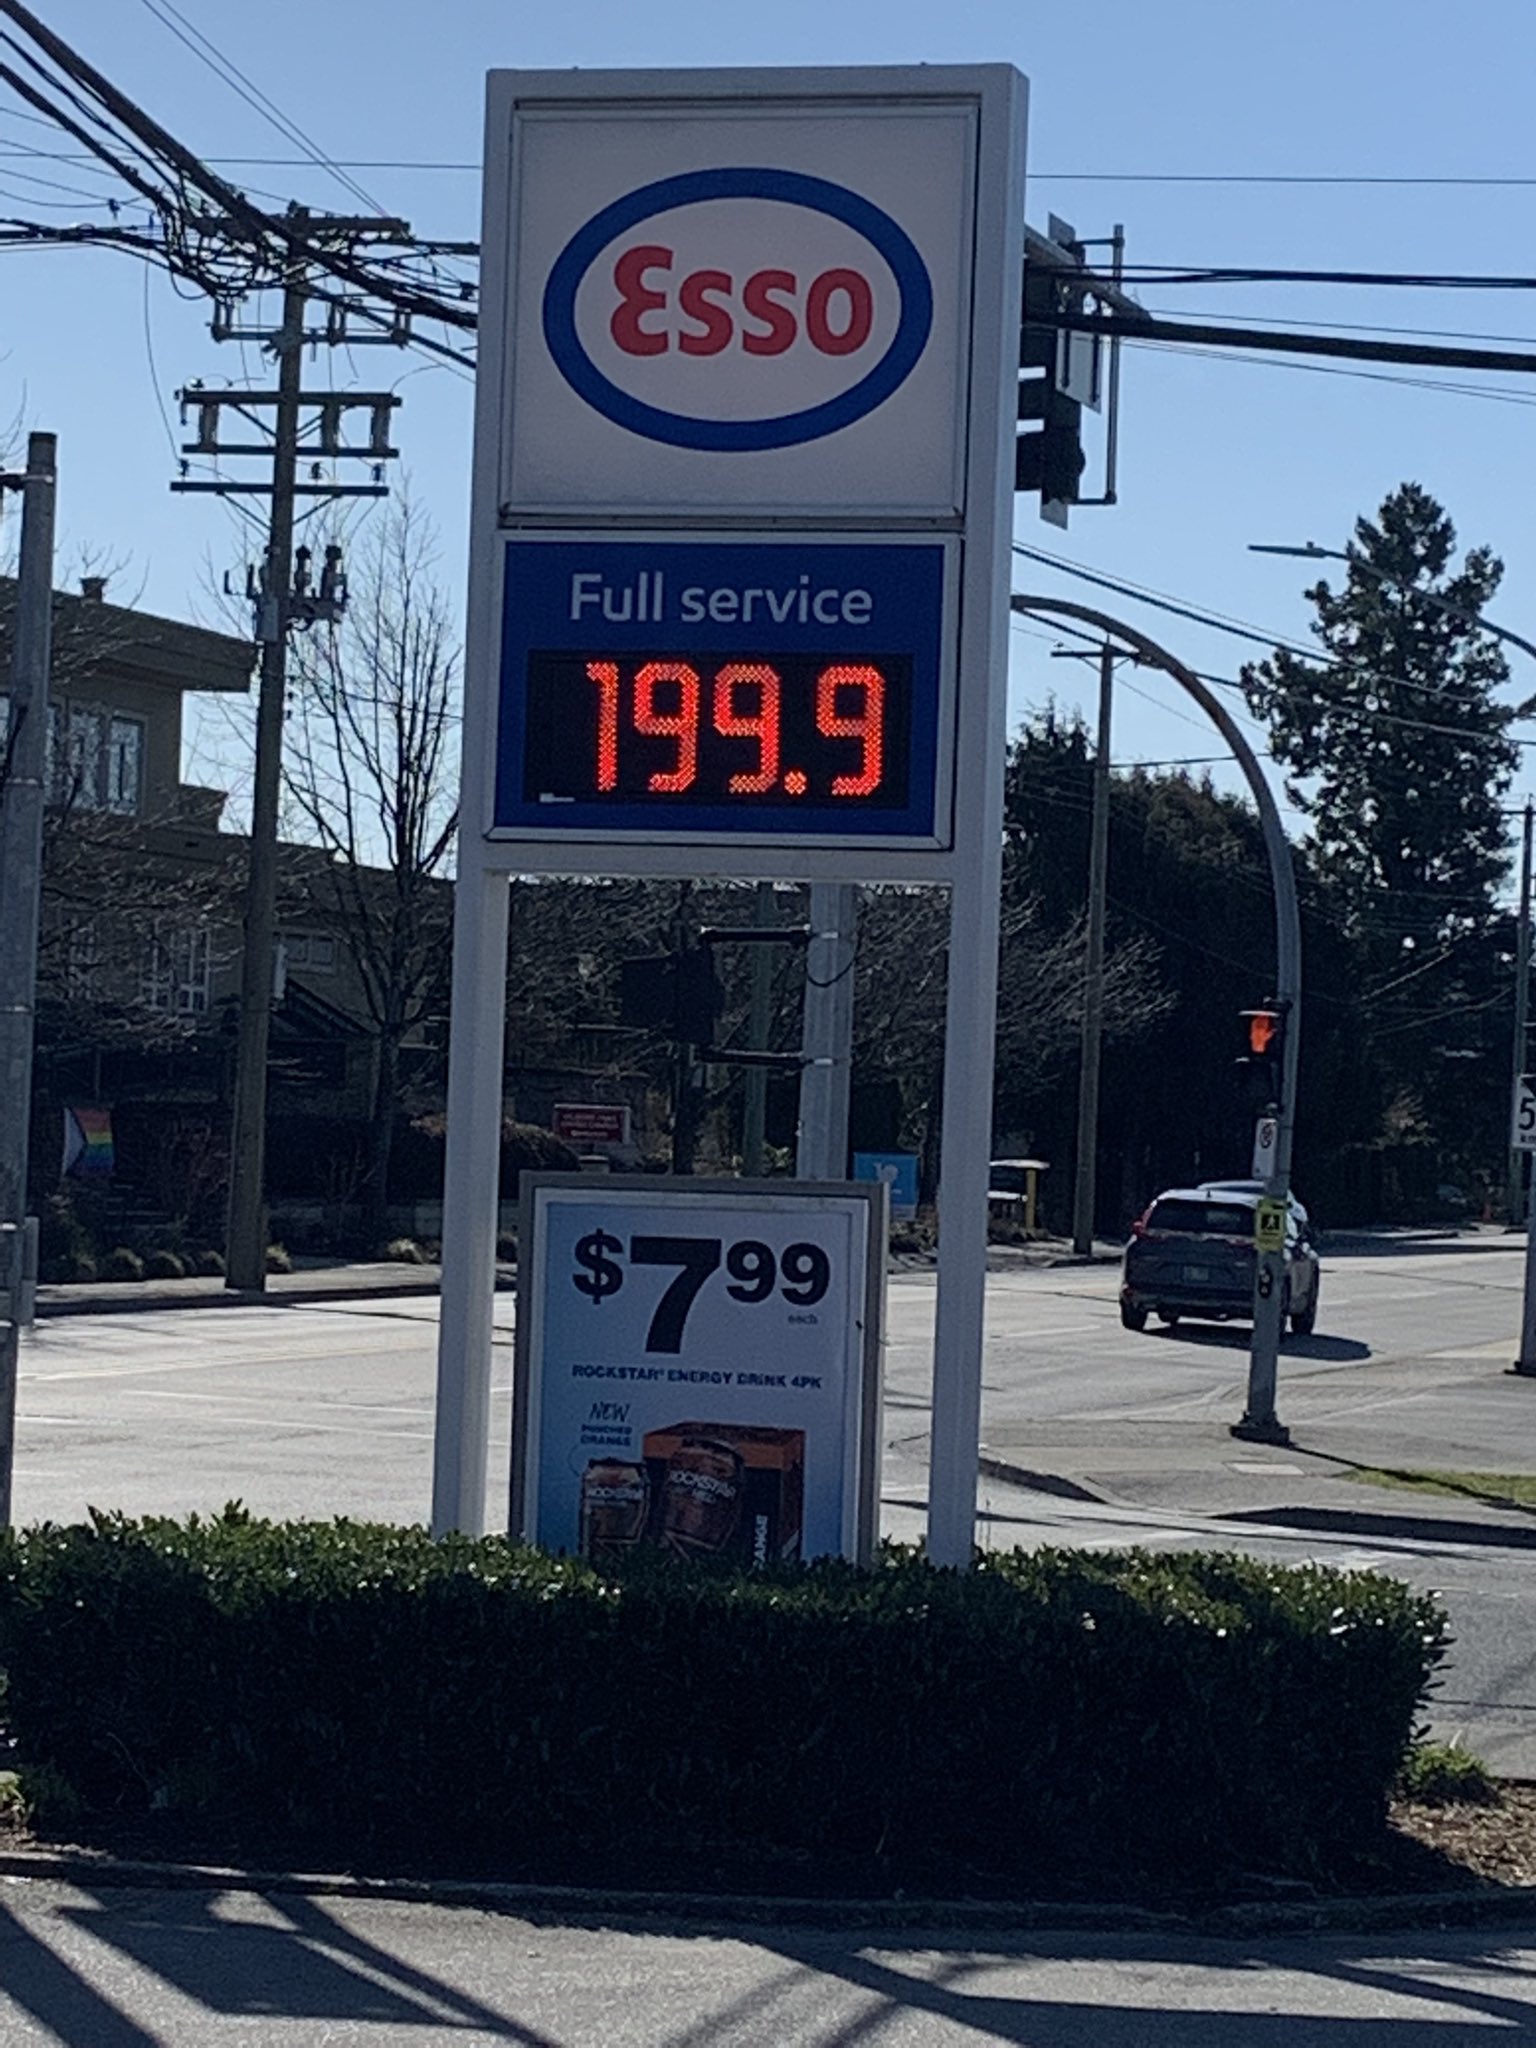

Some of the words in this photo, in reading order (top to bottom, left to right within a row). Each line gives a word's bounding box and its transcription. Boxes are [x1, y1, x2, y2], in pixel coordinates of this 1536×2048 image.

[570, 570, 664, 623] Full
[680, 574, 874, 625] service
[586, 661, 887, 797] 199.9
[788, 1313, 818, 1325] each
[667, 1369, 733, 1385] ENERGY
[736, 1372, 787, 1388] DRINK
[791, 1375, 823, 1389] 4PK
[589, 1401, 631, 1422] NEW
